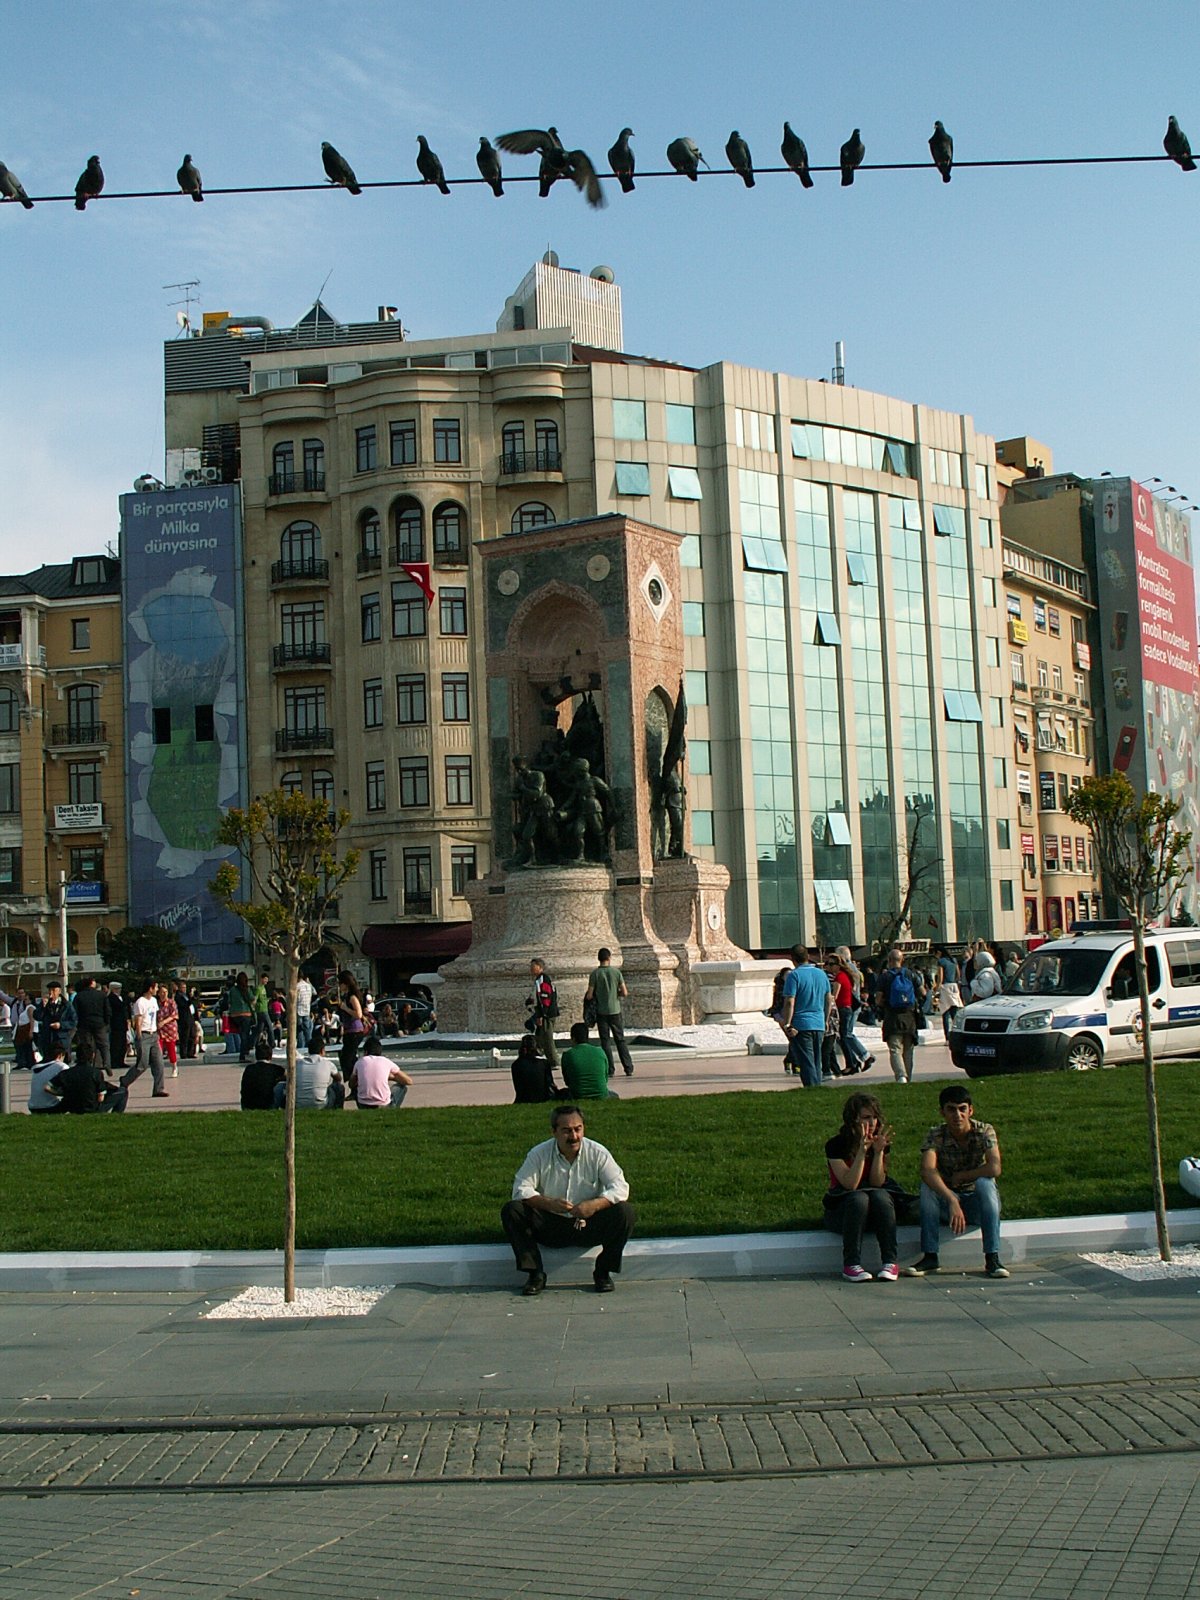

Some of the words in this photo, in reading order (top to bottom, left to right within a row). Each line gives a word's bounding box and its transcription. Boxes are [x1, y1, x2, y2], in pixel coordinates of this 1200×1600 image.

[133, 501, 152, 517] Bir
[156, 495, 229, 518] parçasıyla
[161, 519, 200, 536] Milka
[1134, 519, 1154, 537] vodafone
[144, 537, 218, 555] dünyasına
[1142, 621, 1162, 641] mobil
[1143, 643, 1167, 664] sadece
[75, 804, 99, 813] Taksim
